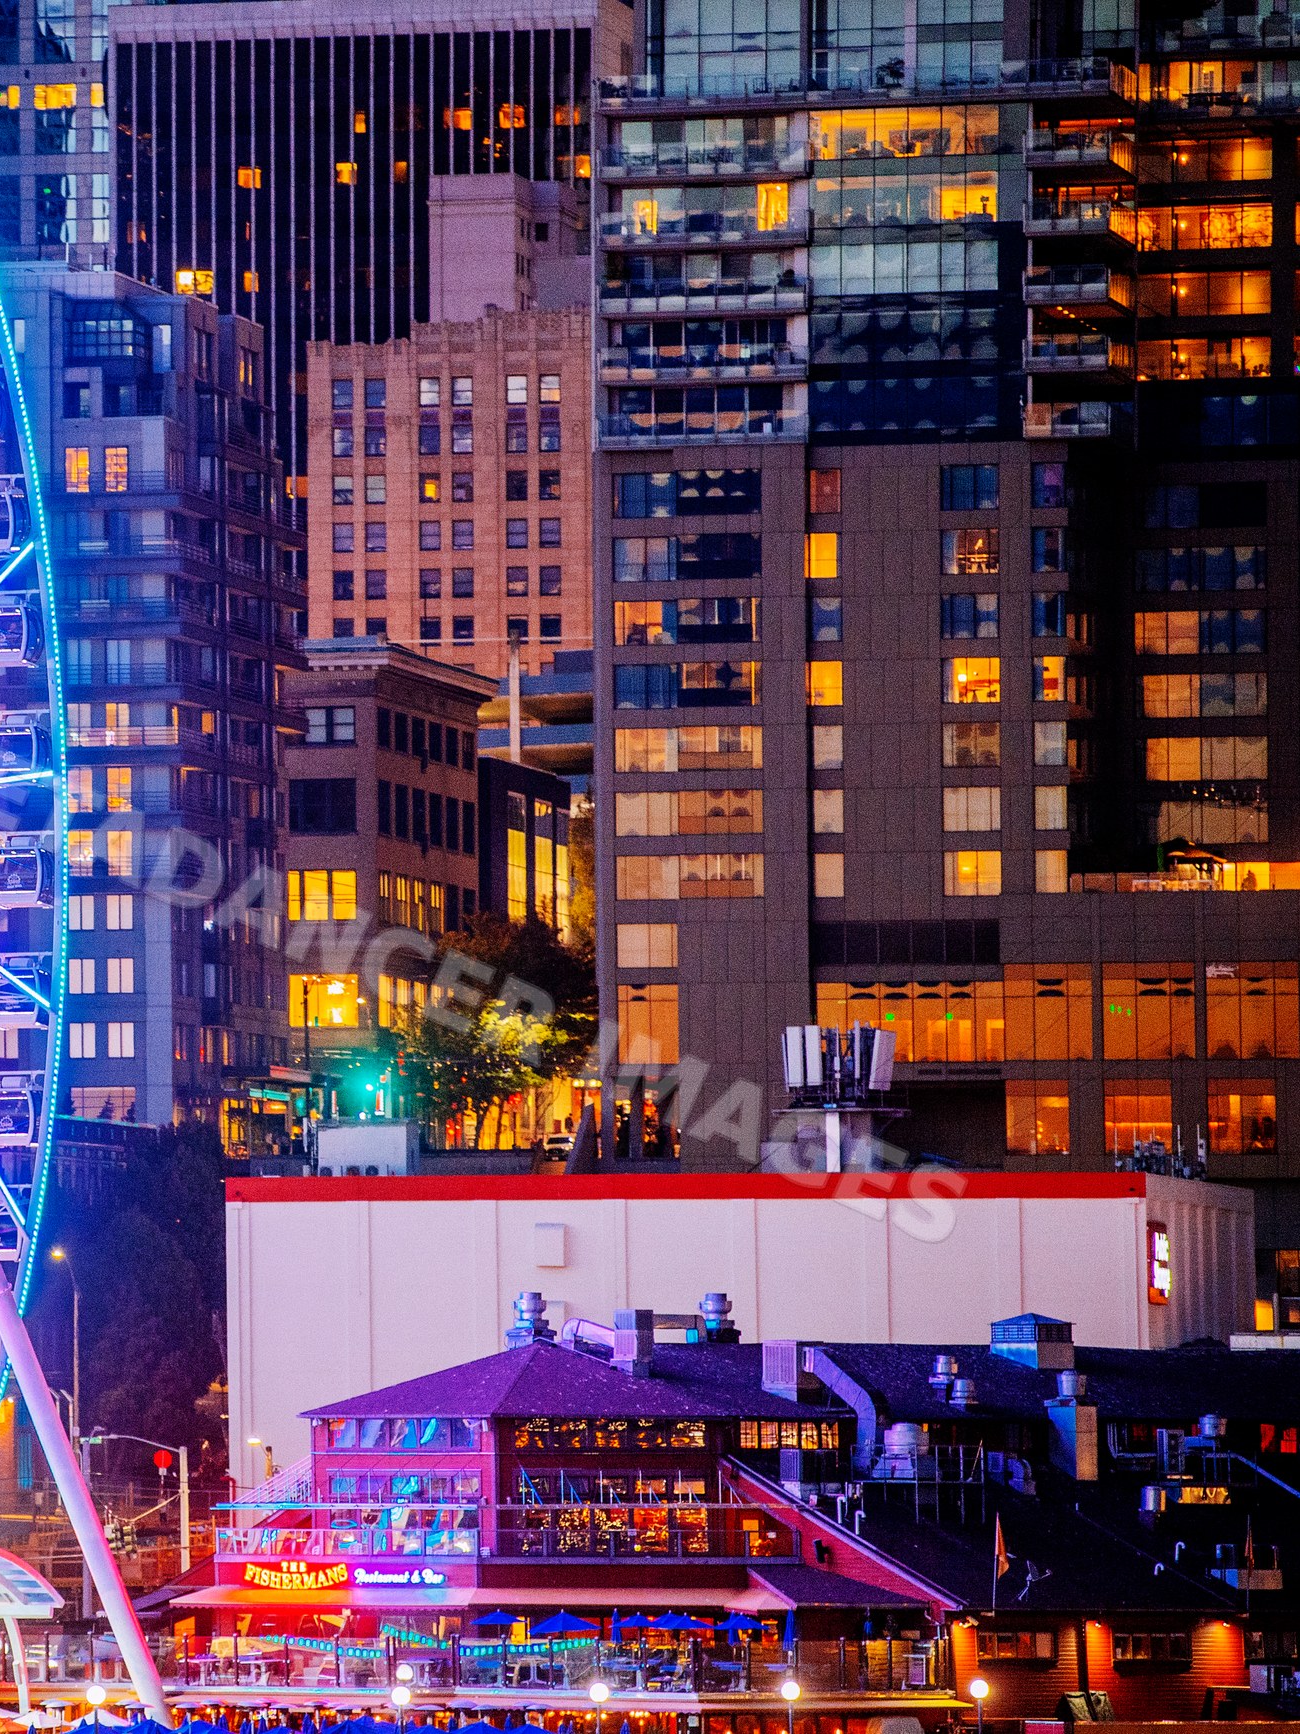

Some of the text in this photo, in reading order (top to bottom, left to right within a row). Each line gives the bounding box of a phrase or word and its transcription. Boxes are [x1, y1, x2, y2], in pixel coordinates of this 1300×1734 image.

[281, 1561, 307, 1573] THE
[353, 1567, 410, 1585] Restaurant
[421, 1567, 445, 1585] Bar
[244, 1563, 349, 1590] FISHERMANS
